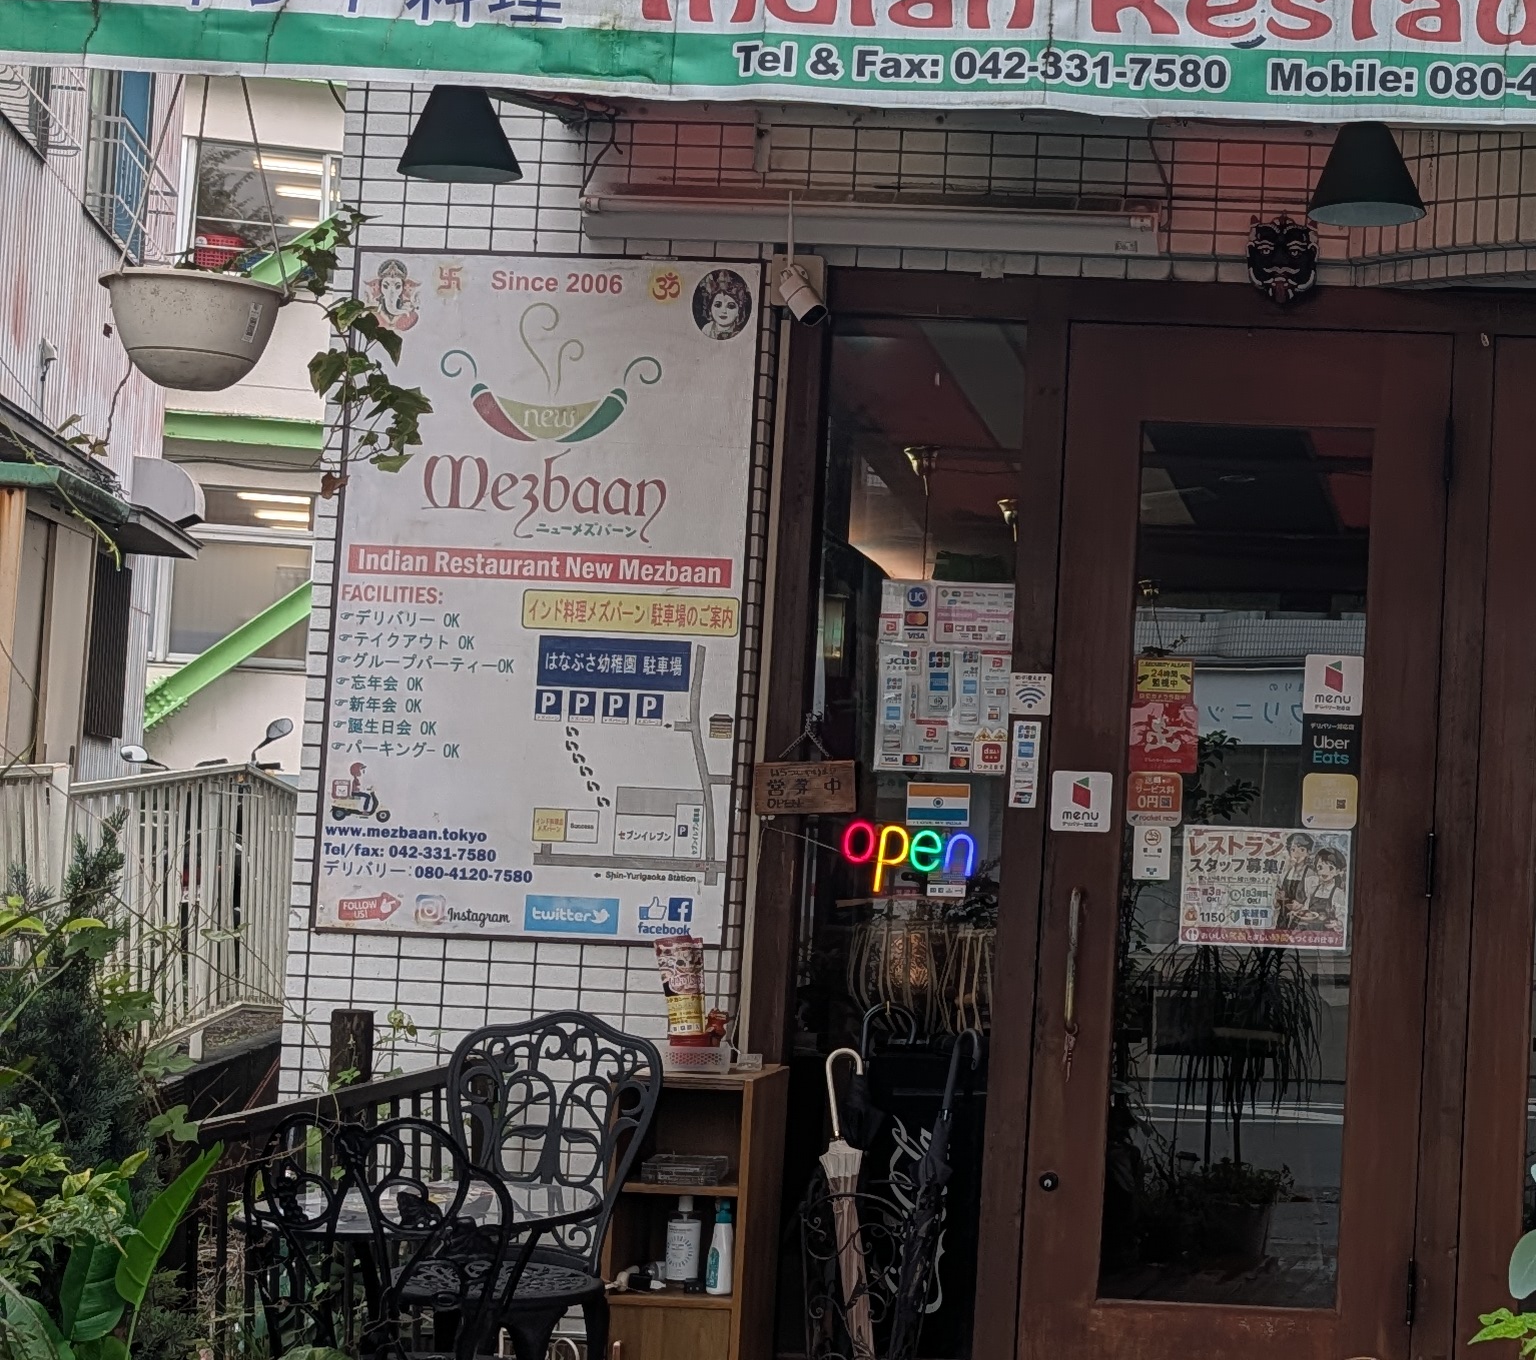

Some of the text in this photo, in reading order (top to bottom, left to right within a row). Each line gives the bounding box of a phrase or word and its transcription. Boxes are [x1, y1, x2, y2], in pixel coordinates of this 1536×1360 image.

[735, 44, 1227, 91] Tel & Fax: 042-331-7580
[1270, 61, 1413, 94] Mobile:
[491, 271, 622, 294] Since 2006
[523, 407, 577, 428] new
[421, 450, 666, 543] Mezbaan
[536, 523, 636, 537] ニューメズバーン
[358, 549, 721, 583] Indian Restaurant New Mezbaan
[341, 584, 443, 604] FACILITIES:
[356, 609, 460, 627] デリバリー OK
[354, 632, 475, 650] テイクアウト OK
[643, 656, 682, 676] 駐車場
[351, 675, 423, 691] 忘年会 OK
[349, 697, 422, 713] 新年会 OK
[541, 692, 556, 713] P
[574, 693, 590, 714] P
[608, 695, 623, 716] P
[642, 696, 657, 717] P
[1315, 694, 1351, 704] menu
[347, 718, 436, 736] 誕生日会 OK
[443, 743, 460, 758] OK
[1313, 735, 1350, 749] Uber
[1312, 750, 1350, 764] Eats
[1062, 810, 1099, 821] menu
[325, 825, 487, 844] www.mezbaan.tokyo
[618, 831, 671, 841] セブンイレブン
[324, 842, 496, 862] Tel/fax: 042-331-7580
[1189, 835, 1285, 857] レストラン
[843, 821, 975, 893] open
[414, 865, 532, 883] 080-4120-7580
[342, 899, 377, 911] FOLLOW
[353, 910, 368, 919] US!
[447, 907, 511, 928] Instagram
[532, 907, 591, 922] twitter
[638, 921, 691, 935] facebook
